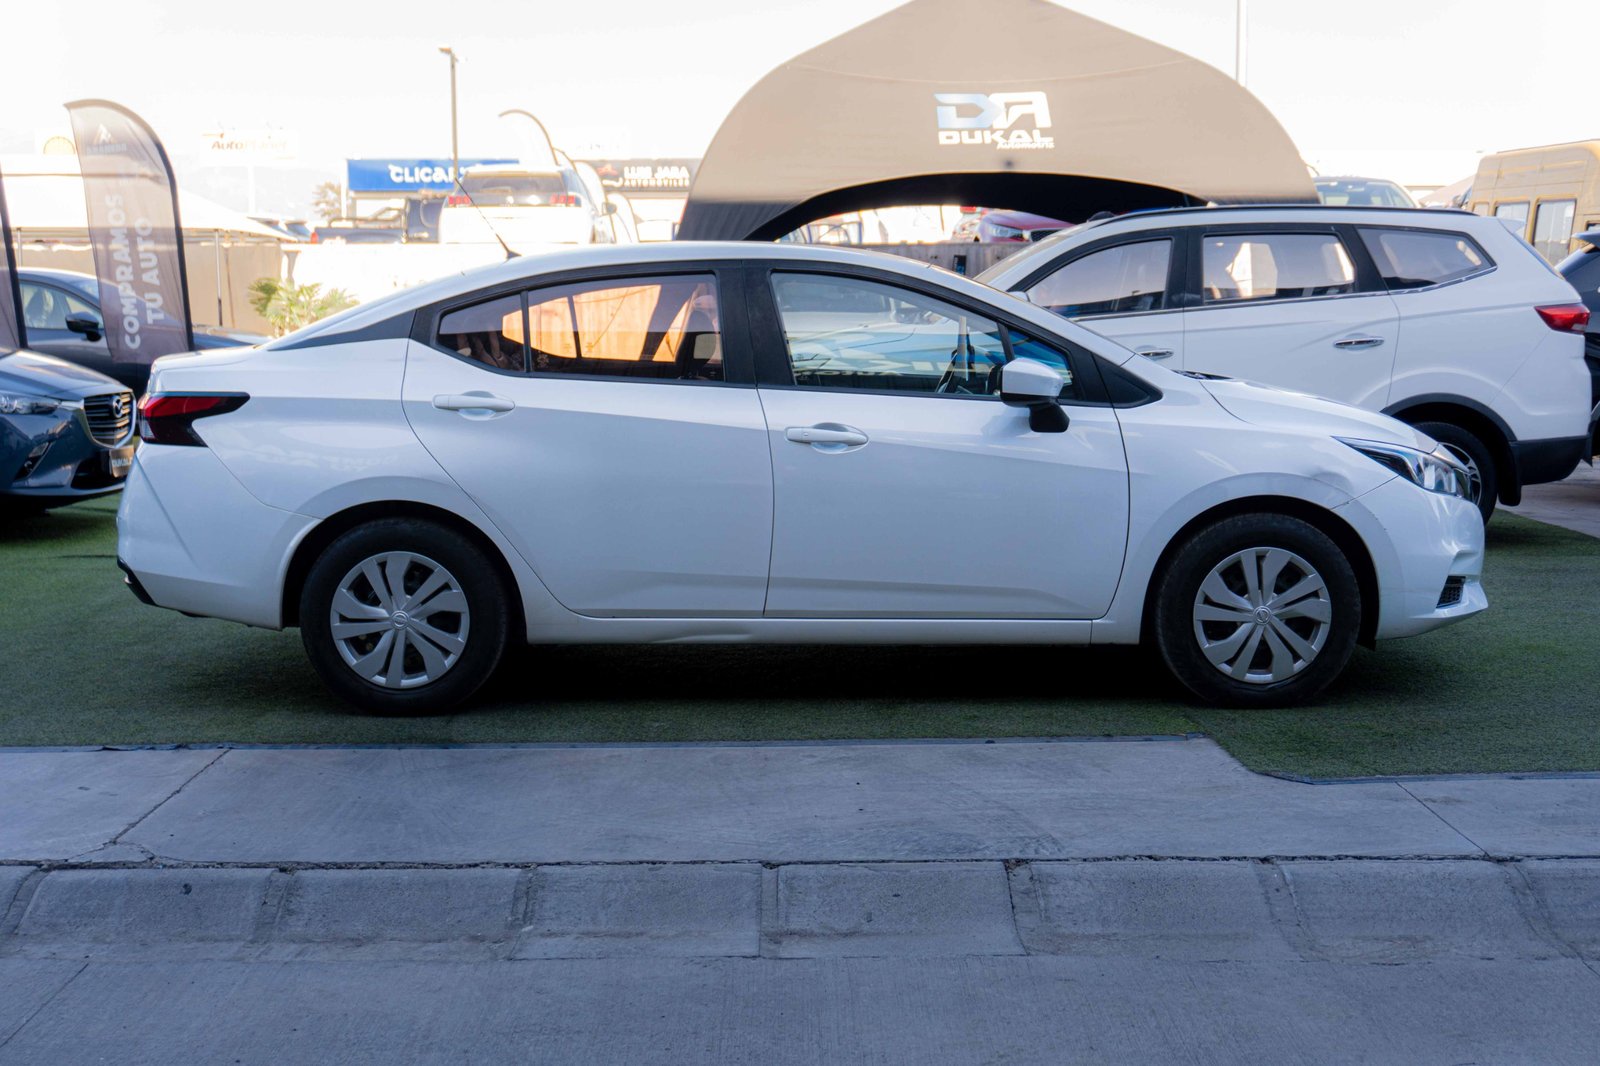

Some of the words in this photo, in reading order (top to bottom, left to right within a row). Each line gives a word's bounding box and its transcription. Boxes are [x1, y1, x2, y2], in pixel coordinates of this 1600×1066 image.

[938, 130, 1055, 145] DUKAL
[105, 193, 141, 350] COMPRAMOS
[134, 216, 161, 287] AUTO
[144, 292, 165, 325] TU
